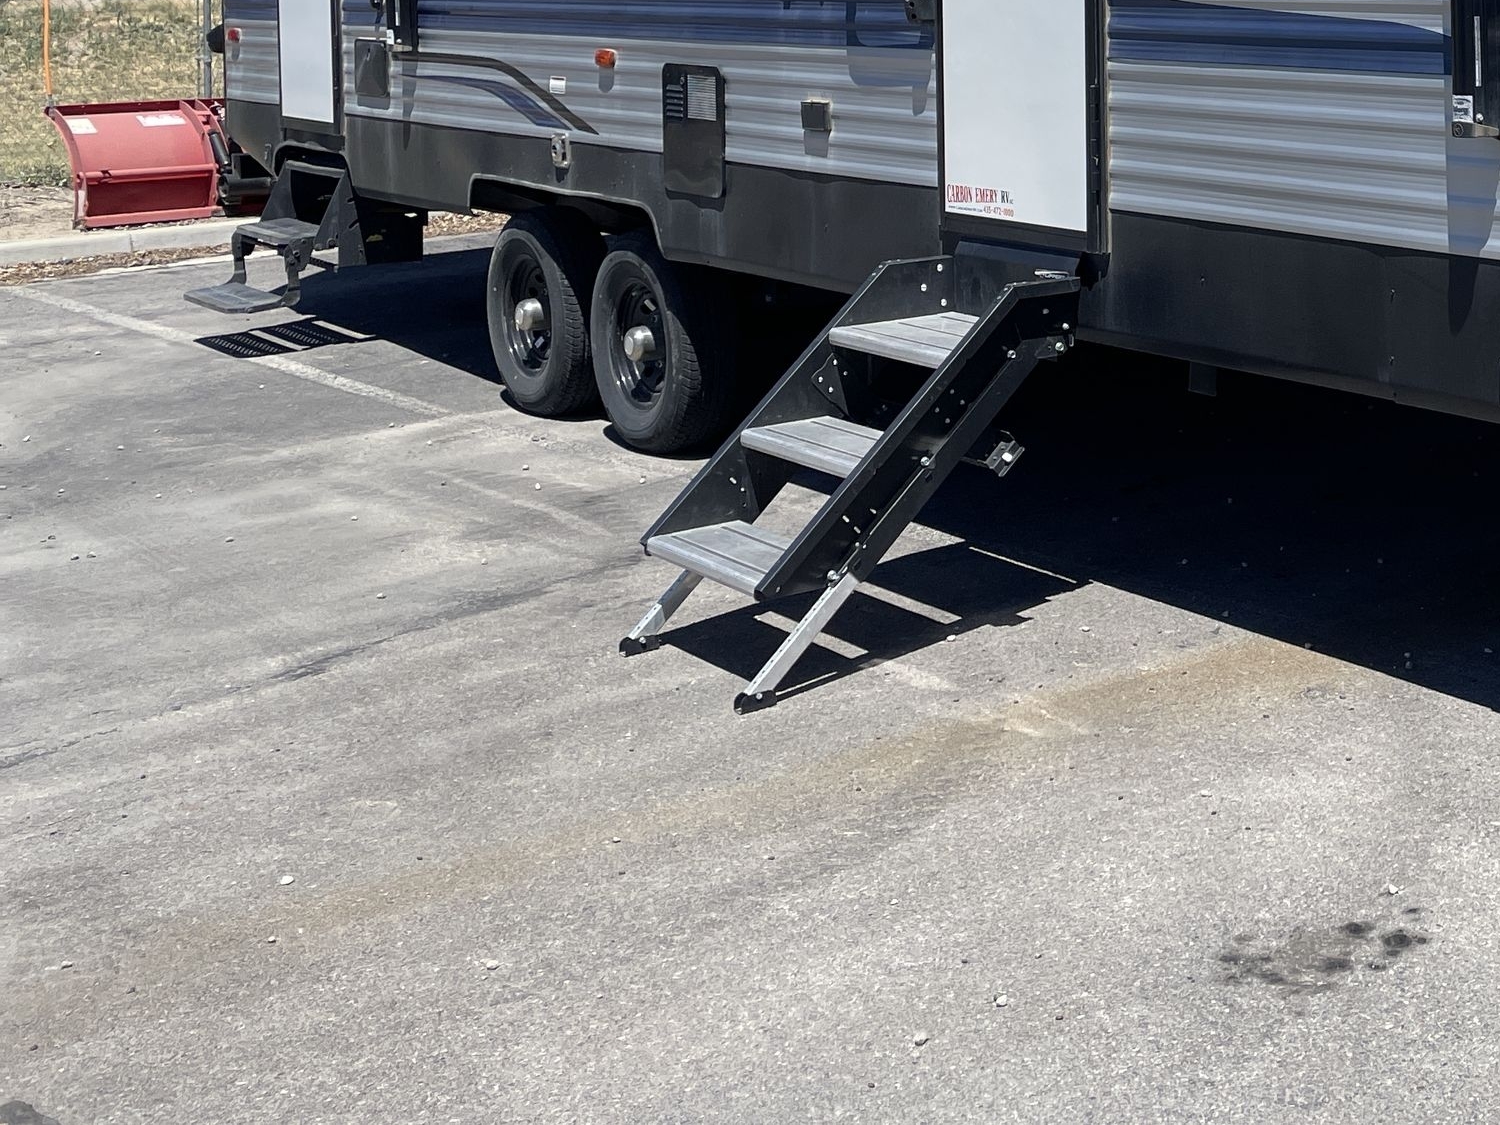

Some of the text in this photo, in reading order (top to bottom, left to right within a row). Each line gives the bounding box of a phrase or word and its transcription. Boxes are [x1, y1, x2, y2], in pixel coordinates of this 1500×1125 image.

[947, 184, 973, 203] CARBON
[975, 187, 998, 204] EMERY
[1001, 190, 1009, 204] RV
